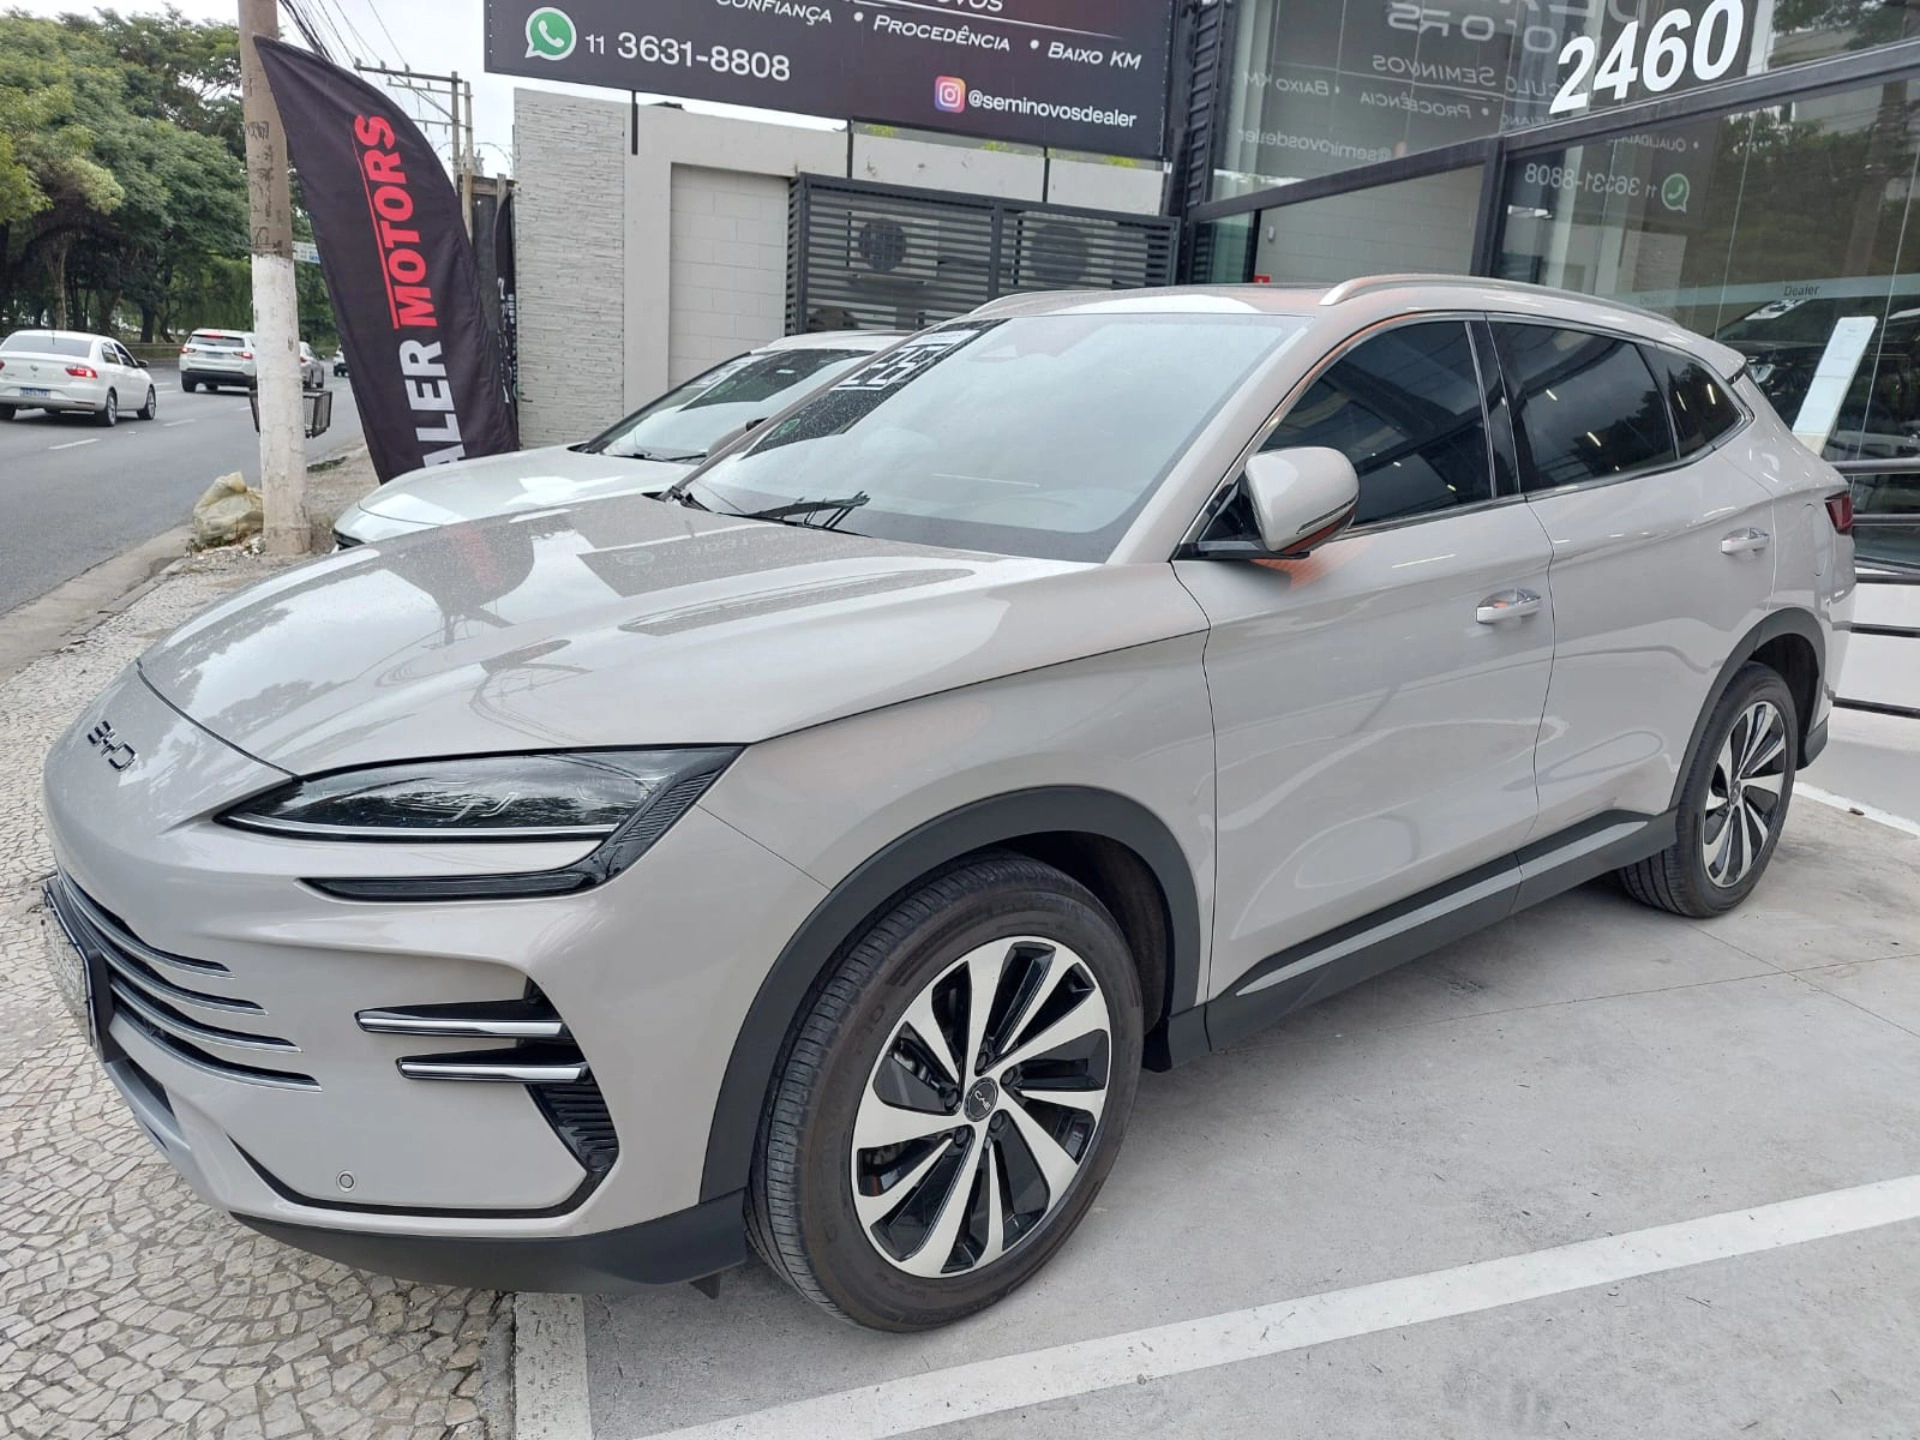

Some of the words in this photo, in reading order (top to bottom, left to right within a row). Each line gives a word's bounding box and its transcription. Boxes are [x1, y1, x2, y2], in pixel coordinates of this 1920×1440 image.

[585, 34, 605, 55] 11
[617, 32, 791, 82] 3631-8808
[872, 15, 1011, 52] PROCEDÊNCIA
[1047, 42, 1104, 65] BAIXO
[1109, 49, 1142, 71] KM
[1549, 0, 1744, 115] 2460
[968, 89, 1138, 128] @seminovosdealer
[354, 114, 438, 327] MOTORS
